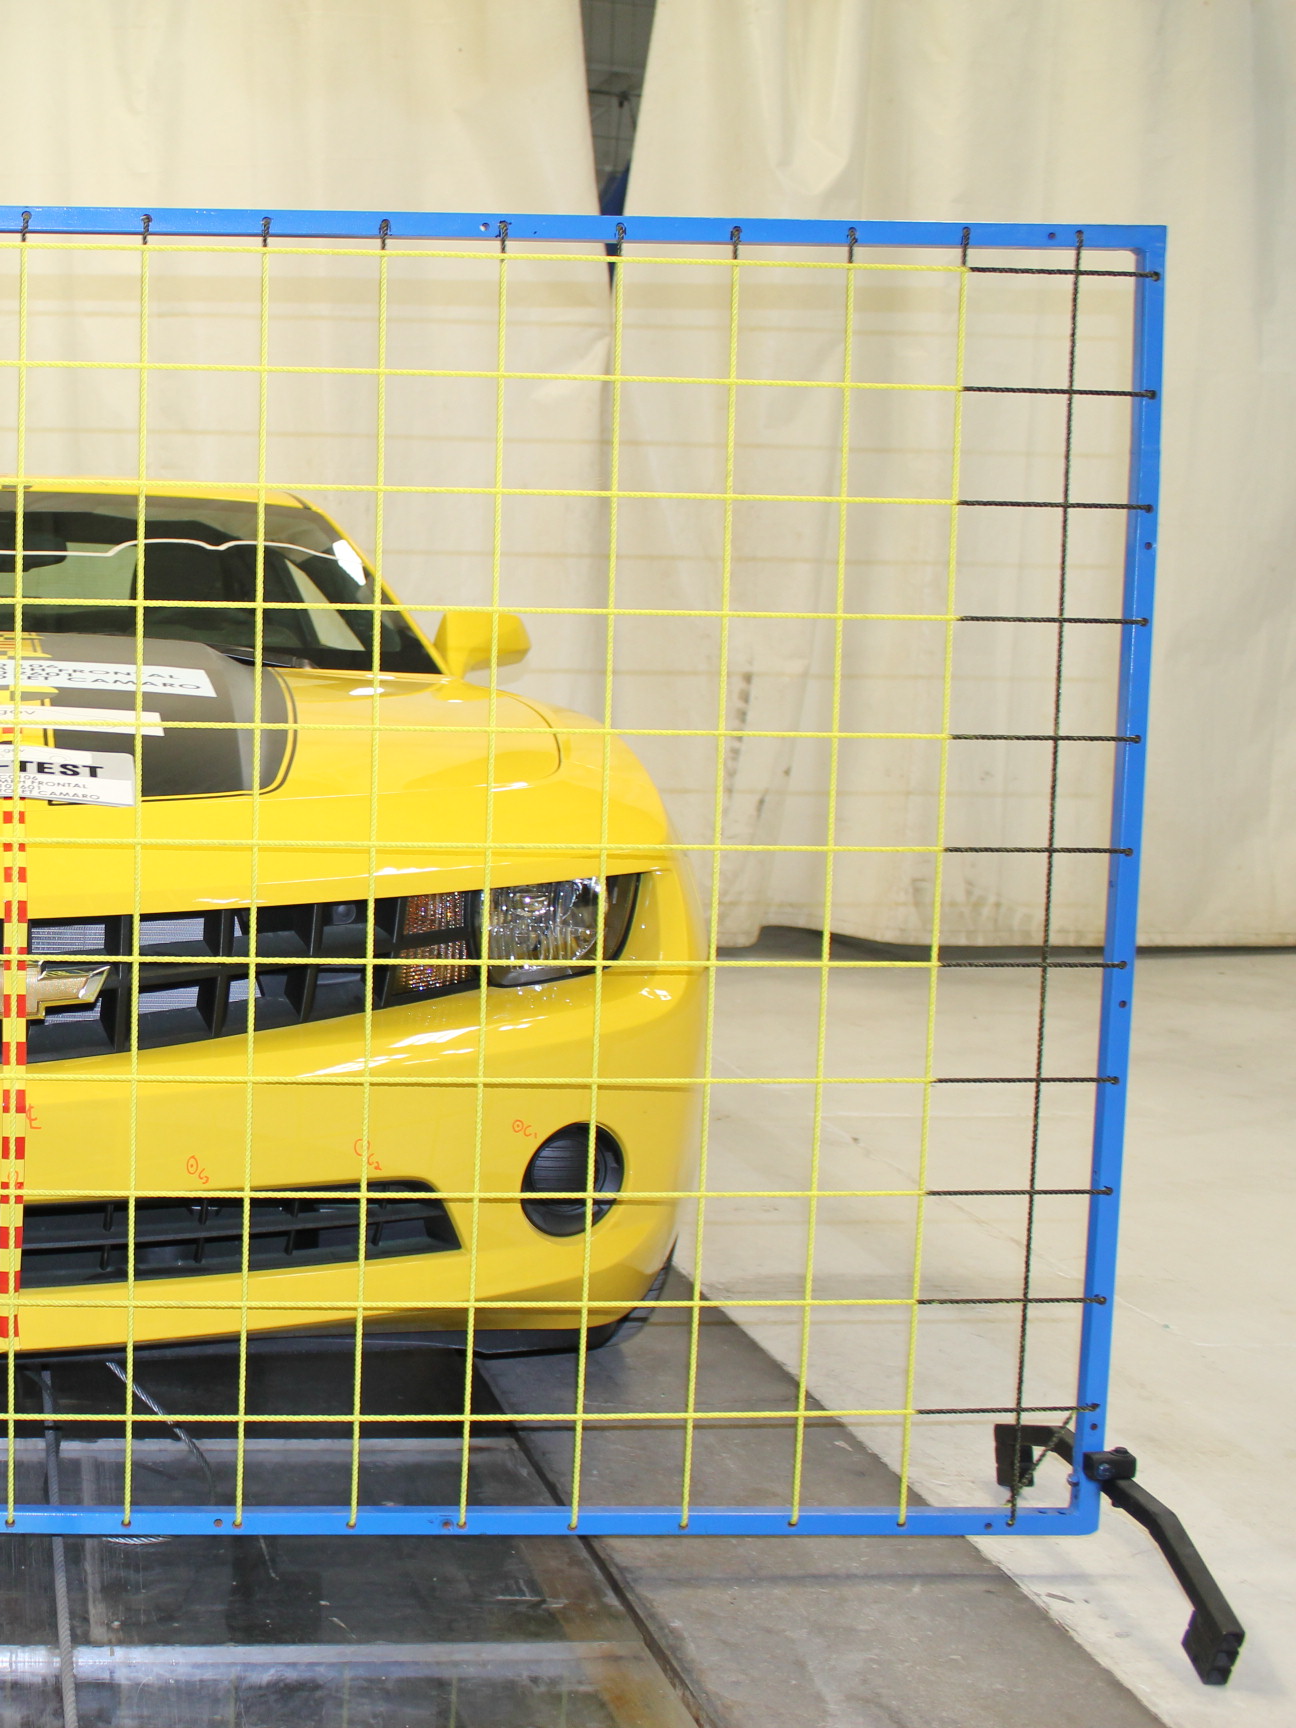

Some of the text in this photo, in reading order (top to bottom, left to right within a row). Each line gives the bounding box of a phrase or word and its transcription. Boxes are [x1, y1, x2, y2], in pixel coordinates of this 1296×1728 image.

[58, 668, 180, 679] FRONAL
[67, 677, 201, 690] CAMARO
[31, 780, 88, 789] FRONTAL
[38, 790, 100, 800] CAMARO
